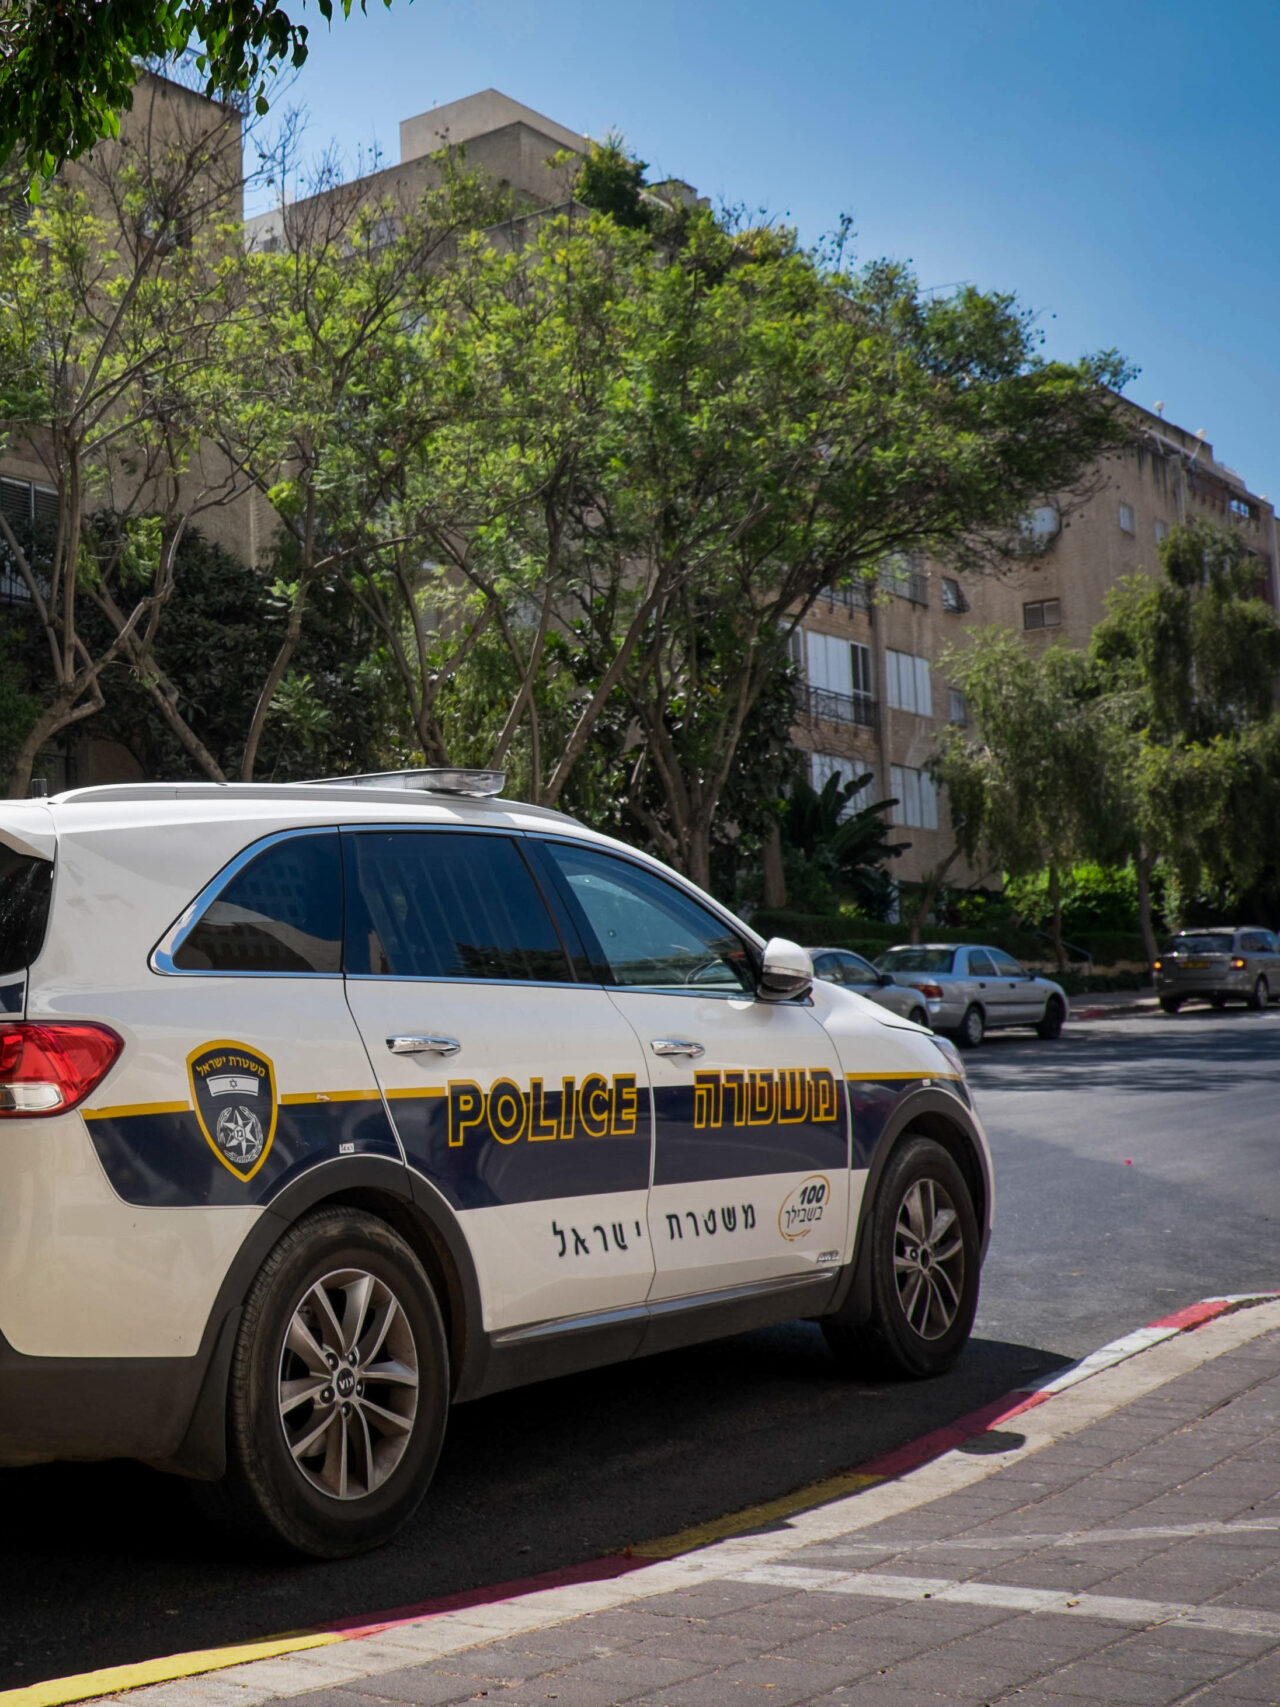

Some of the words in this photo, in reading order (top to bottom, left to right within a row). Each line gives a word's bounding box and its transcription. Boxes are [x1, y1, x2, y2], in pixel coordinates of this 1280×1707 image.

[196, 1056, 227, 1077] ישראל
[228, 1055, 266, 1077] משטרת
[447, 1072, 637, 1147] POLICE
[694, 1067, 838, 1129] משטרה
[800, 1184, 826, 1205] 100
[666, 1203, 756, 1241] משטרת
[785, 1205, 823, 1229] בשבילך
[552, 1220, 641, 1258] ישראל
[338, 1375, 355, 1391] KIA
